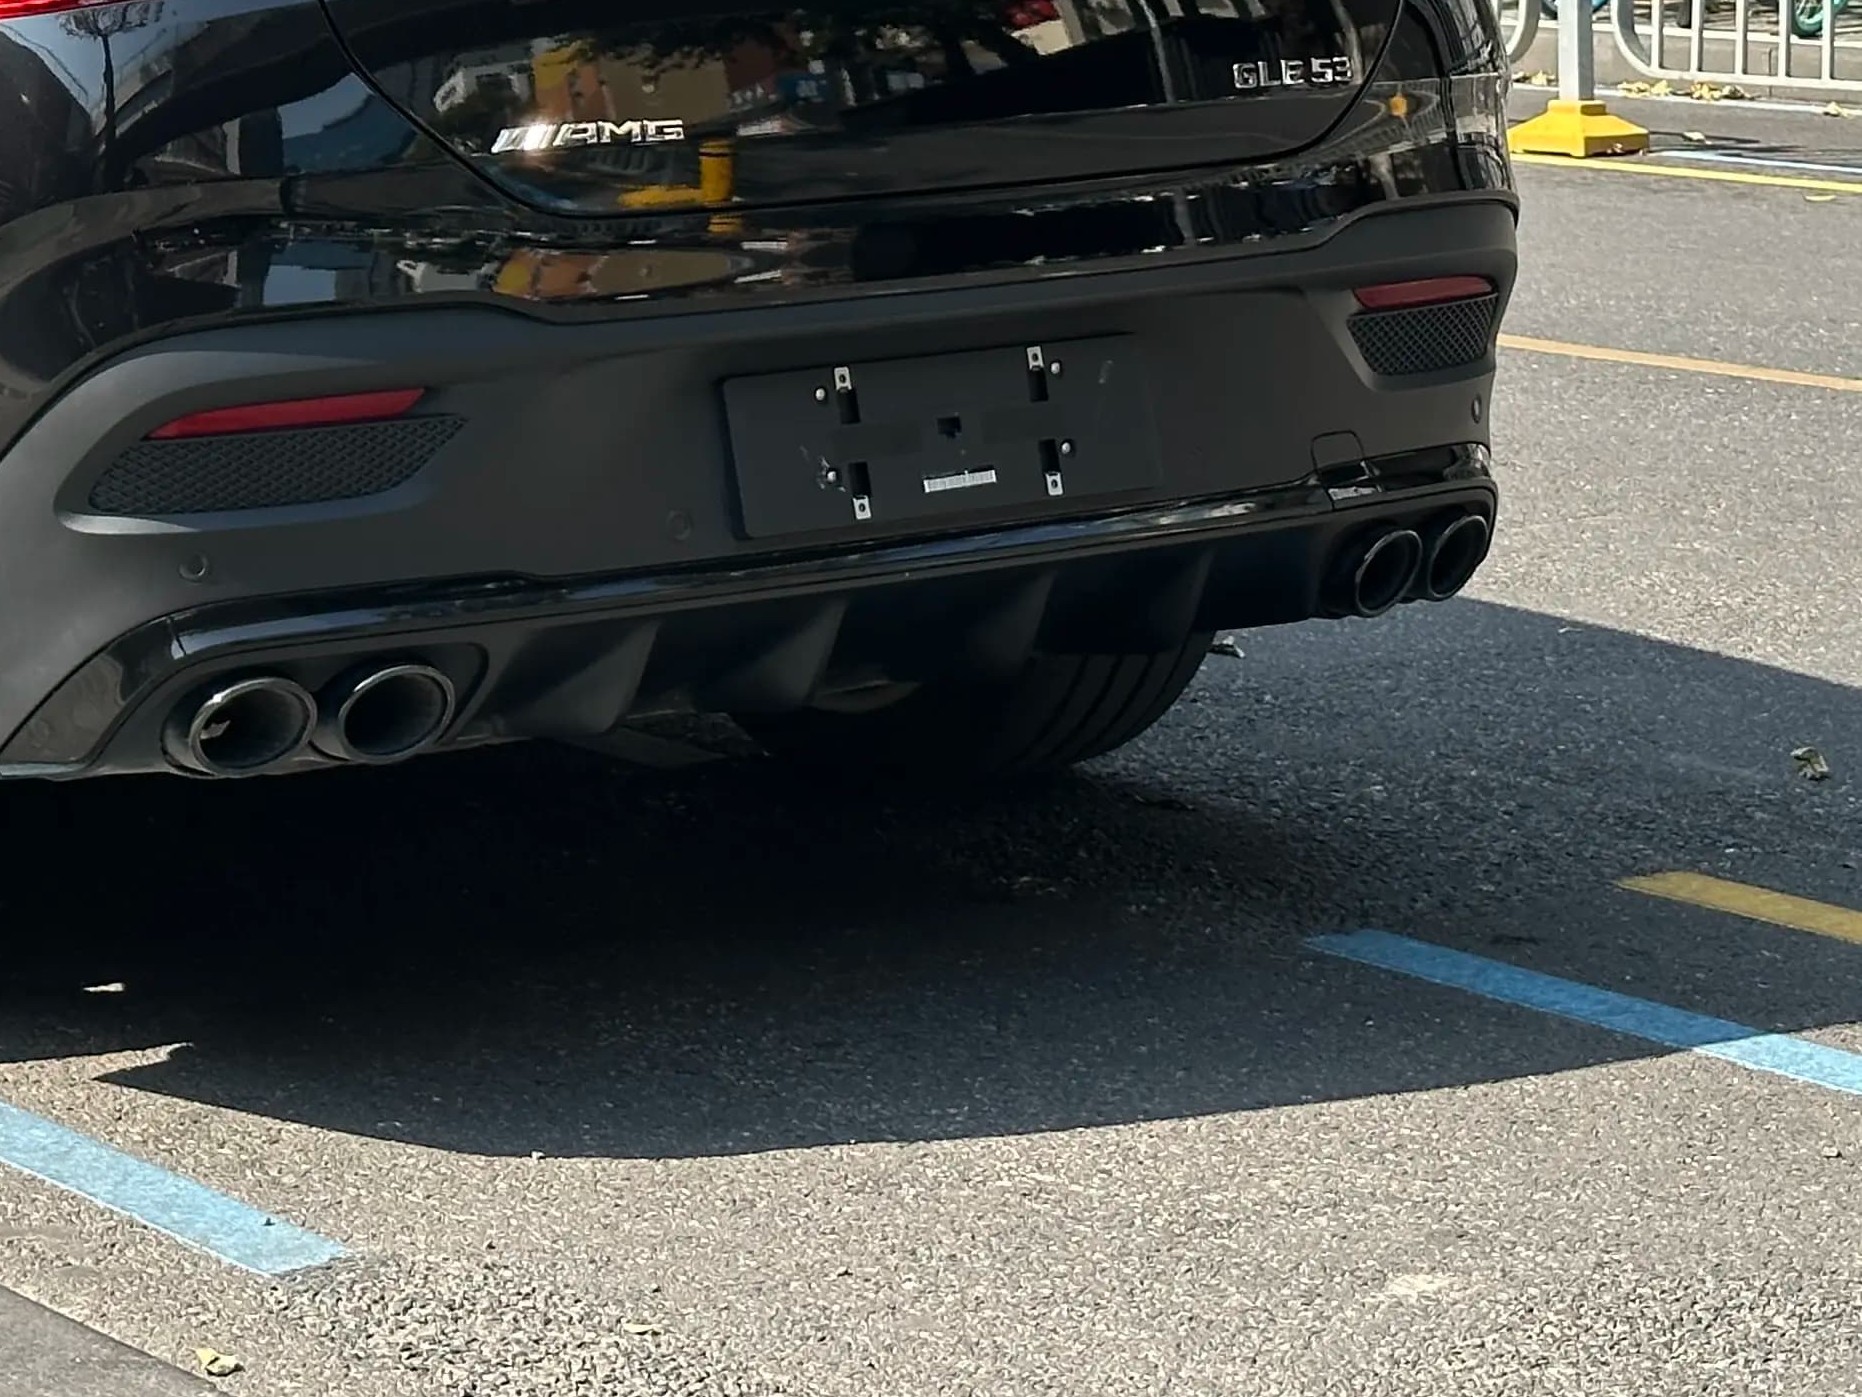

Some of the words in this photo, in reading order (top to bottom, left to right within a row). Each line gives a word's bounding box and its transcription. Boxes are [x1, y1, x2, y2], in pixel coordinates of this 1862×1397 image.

[1232, 59, 1305, 89] GLE
[1310, 56, 1352, 83] 53
[553, 119, 685, 147] AMG
